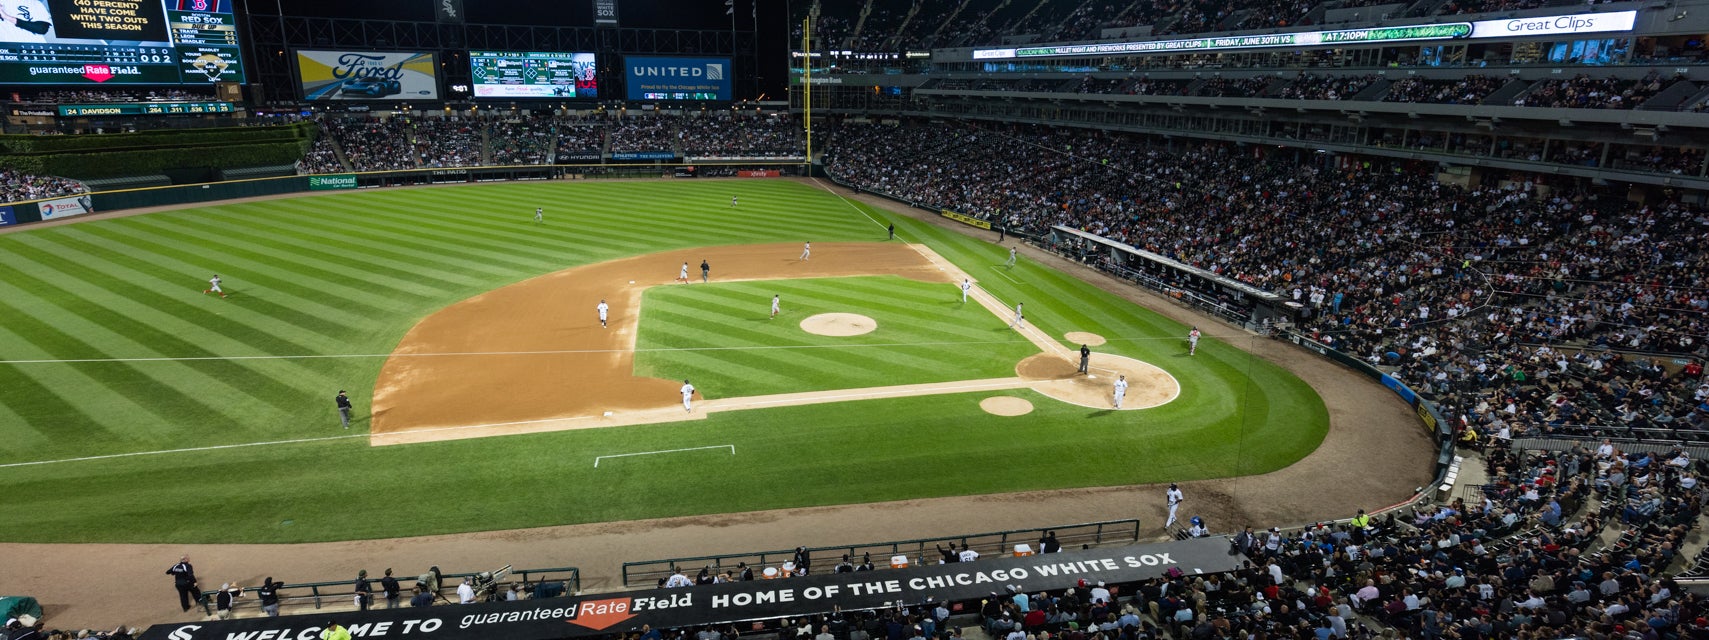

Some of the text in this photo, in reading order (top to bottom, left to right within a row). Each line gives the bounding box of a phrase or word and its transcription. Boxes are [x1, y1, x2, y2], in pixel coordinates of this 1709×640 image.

[93, 0, 139, 10] PERCENT)
[80, 7, 107, 15] HAVE
[70, 14, 96, 22] WITH
[104, 23, 141, 31] SEASON
[1507, 16, 1593, 31] Great Clips
[1326, 33, 1338, 41] AT
[1340, 31, 1368, 40] 7:10PM
[1215, 38, 1241, 47] FRIDAY,
[1242, 37, 1260, 46] JUNE
[1261, 36, 1279, 44] 30TH
[1097, 44, 1125, 52] FIREWORKS
[1126, 43, 1155, 51] PRESENTED
[163, 55, 172, 63] 2
[30, 66, 85, 75] guaranteed
[86, 66, 109, 74] Rate
[332, 53, 404, 80] Ford
[634, 66, 702, 77] UNITED
[800, 77, 829, 85] Hutington
[750, 170, 767, 178] xfinity
[321, 177, 355, 185] National
[402, 617, 443, 634] TO
[459, 604, 578, 629] guaranteed
[580, 601, 627, 617] Rate
[632, 593, 693, 612] Field
[712, 588, 795, 609] HOME
[803, 583, 839, 600] OF
[847, 578, 901, 598] THE
[908, 567, 1029, 591] CHICAGO
[1033, 558, 1120, 577] WHITE
[1123, 552, 1177, 569] SOX
